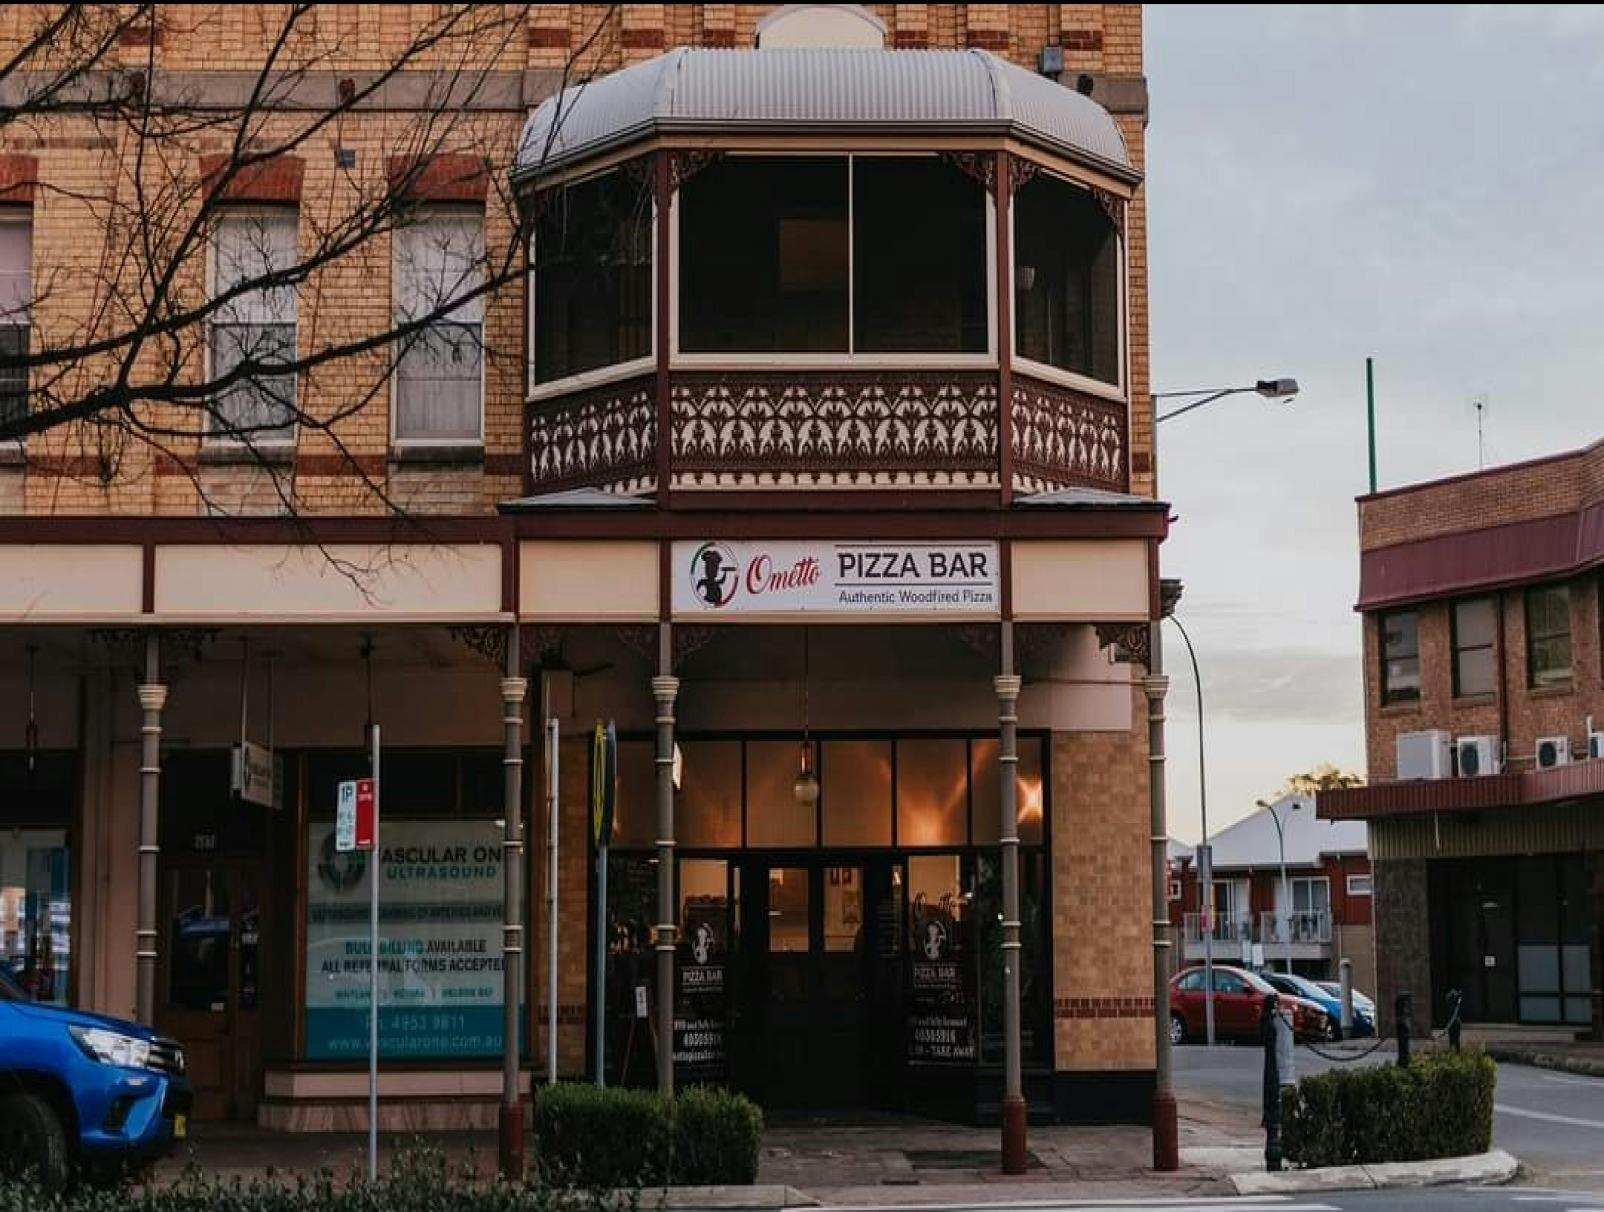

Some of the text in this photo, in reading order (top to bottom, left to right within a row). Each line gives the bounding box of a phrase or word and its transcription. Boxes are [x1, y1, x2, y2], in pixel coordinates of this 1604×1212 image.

[837, 552, 989, 578] PIZZA BAR
[746, 555, 821, 594] Ometto
[839, 589, 993, 603] Authentic Woodfired Pizza
[379, 848, 467, 863] ASCULAR
[386, 865, 498, 880] ULTRASOUND
[427, 939, 487, 953] AVAILABLE
[321, 959, 341, 973] ALL
[404, 958, 447, 973] FORMS
